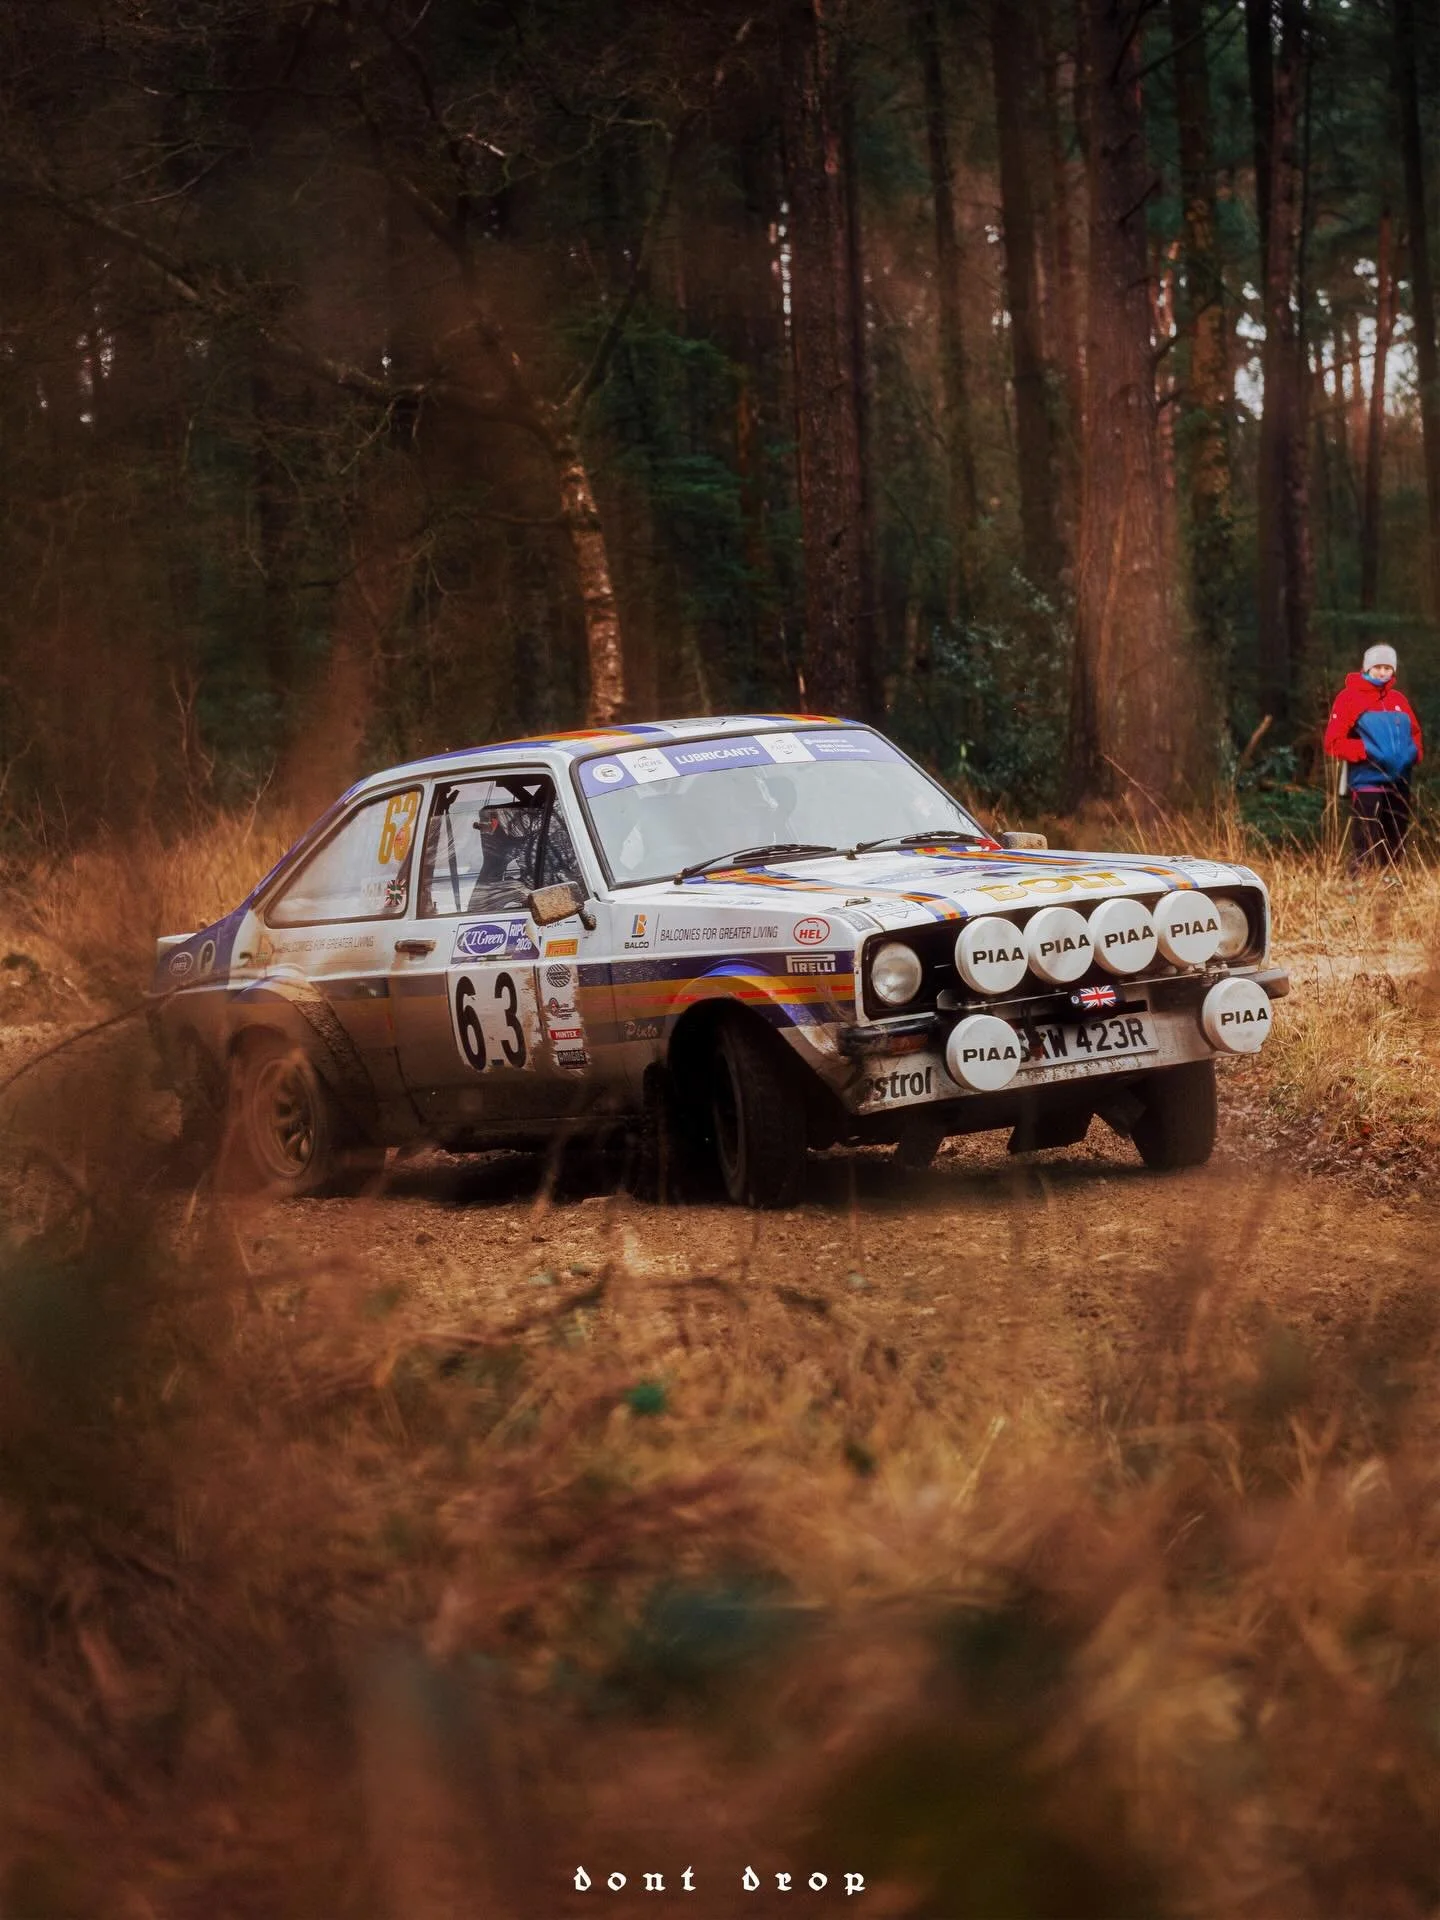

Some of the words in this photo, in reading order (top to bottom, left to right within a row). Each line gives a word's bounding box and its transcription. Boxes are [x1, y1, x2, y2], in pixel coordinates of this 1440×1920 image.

[674, 746, 760, 764] LUBRICANTS
[378, 791, 418, 865] 63
[660, 928, 700, 942] BALCONIES
[702, 927, 717, 940] FOR
[719, 926, 752, 940] GREATER
[753, 925, 779, 939] LIVING
[799, 929, 822, 939] HEL
[1104, 925, 1155, 948] PIAA
[1170, 918, 1219, 938] PIAA
[624, 941, 650, 949] BALCO
[972, 946, 1025, 964] PIAA
[1040, 934, 1091, 957] PIAA
[786, 954, 836, 974] PIRELLI
[456, 972, 527, 1070] 63
[1221, 1006, 1269, 1026] PIAA
[554, 1031, 578, 1039] MINTEX
[1076, 1017, 1148, 1053] 423R
[963, 1046, 1018, 1063] PIAA
